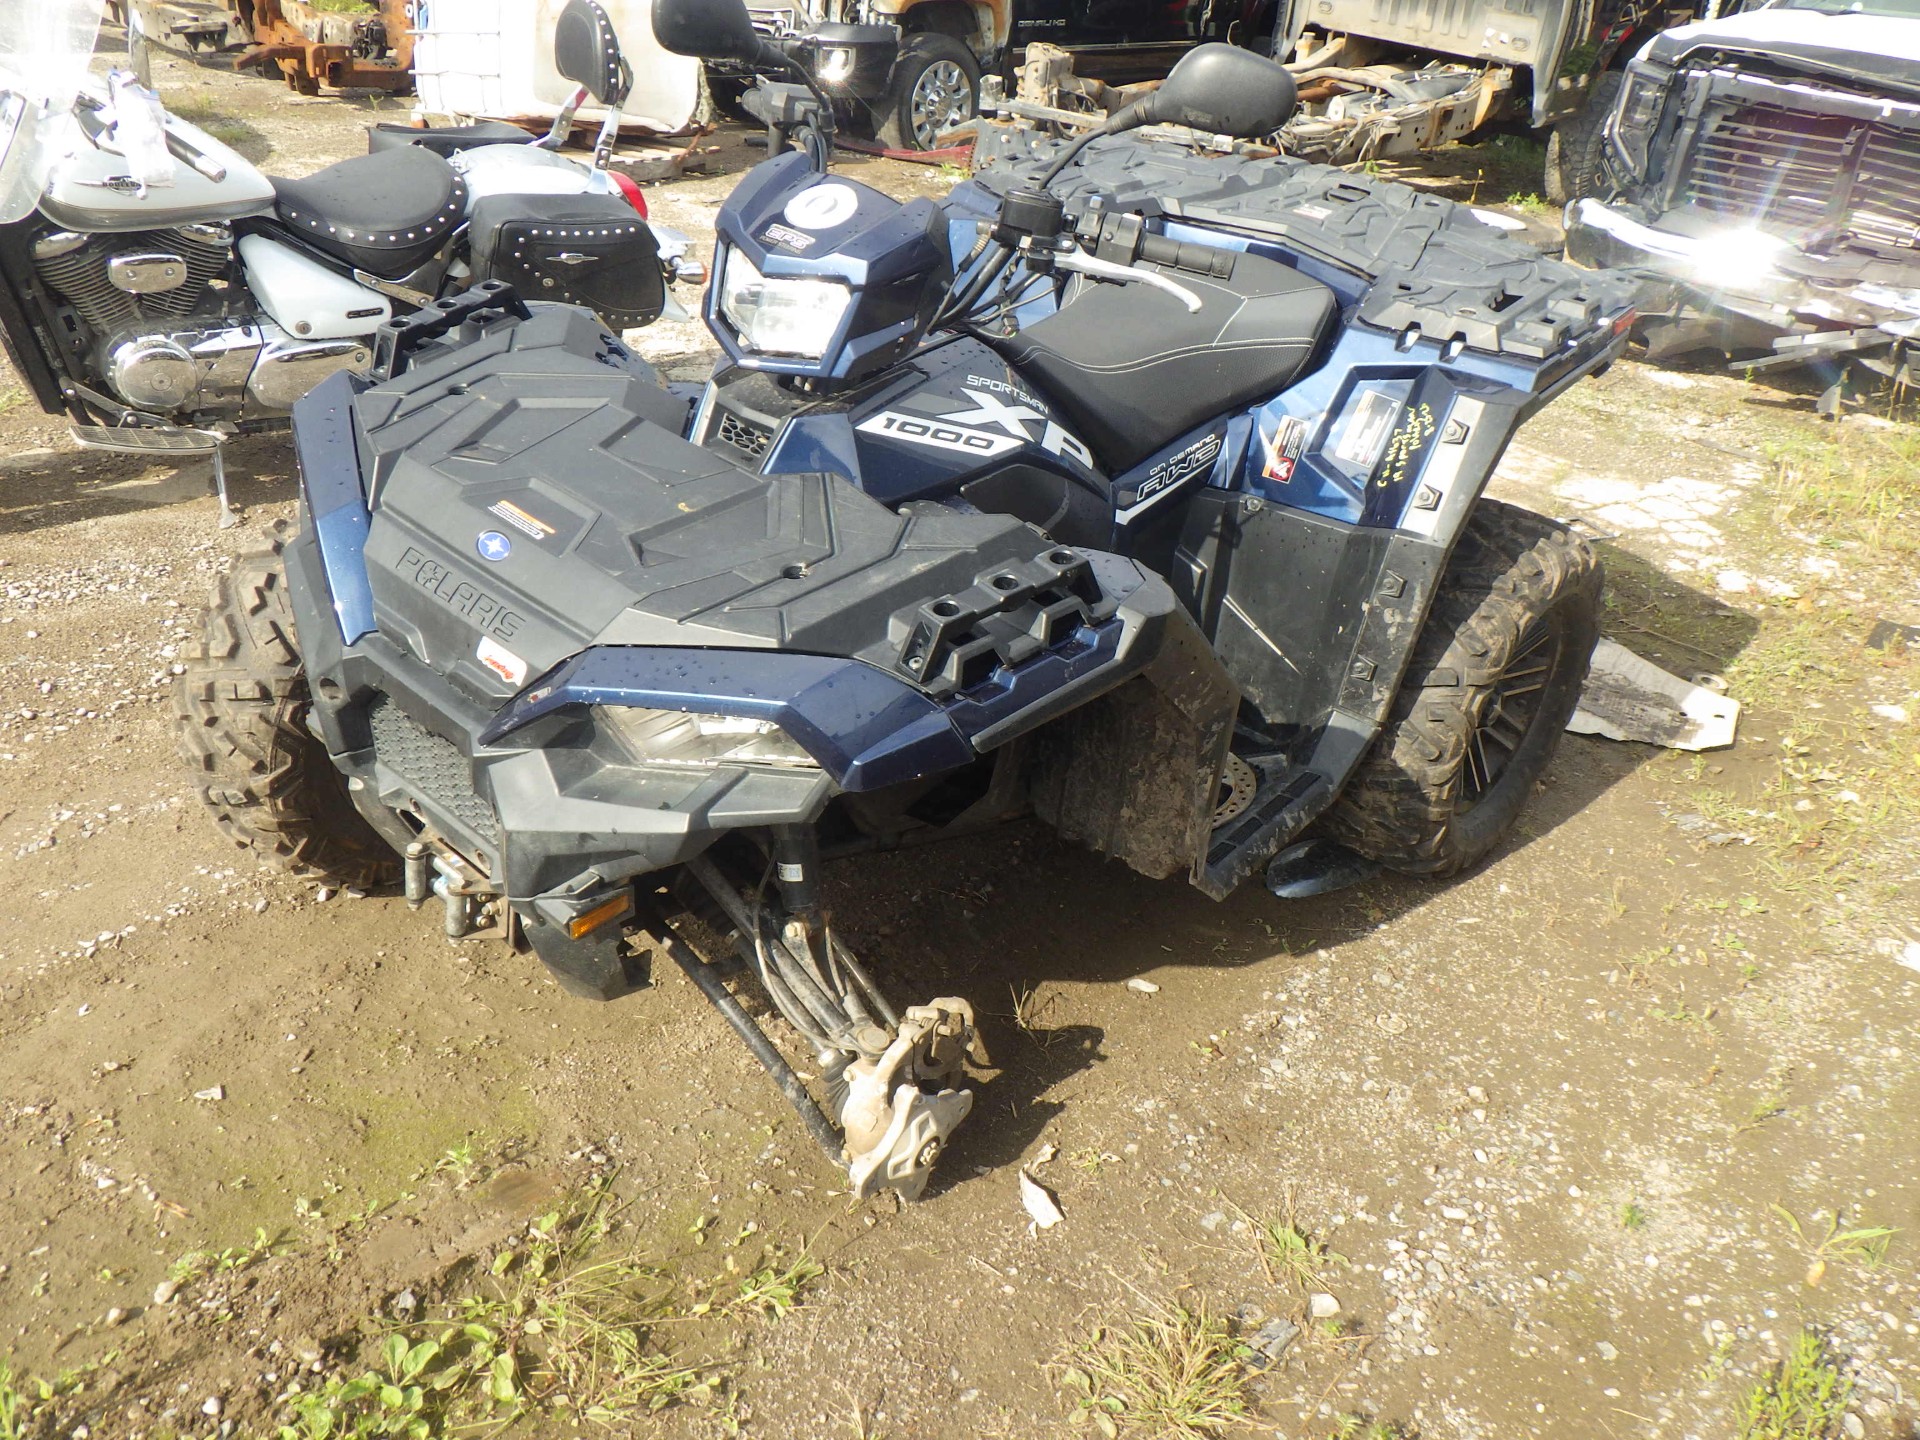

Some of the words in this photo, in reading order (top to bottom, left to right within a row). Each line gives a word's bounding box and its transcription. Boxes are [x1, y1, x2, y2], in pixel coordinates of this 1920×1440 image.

[765, 227, 810, 249] EPS
[965, 374, 1049, 414] SPORTSMAN
[882, 416, 995, 450] 1000
[1169, 433, 1216, 464] DEMAND
[1136, 439, 1221, 502] AWD
[395, 546, 527, 643] POLARIS
